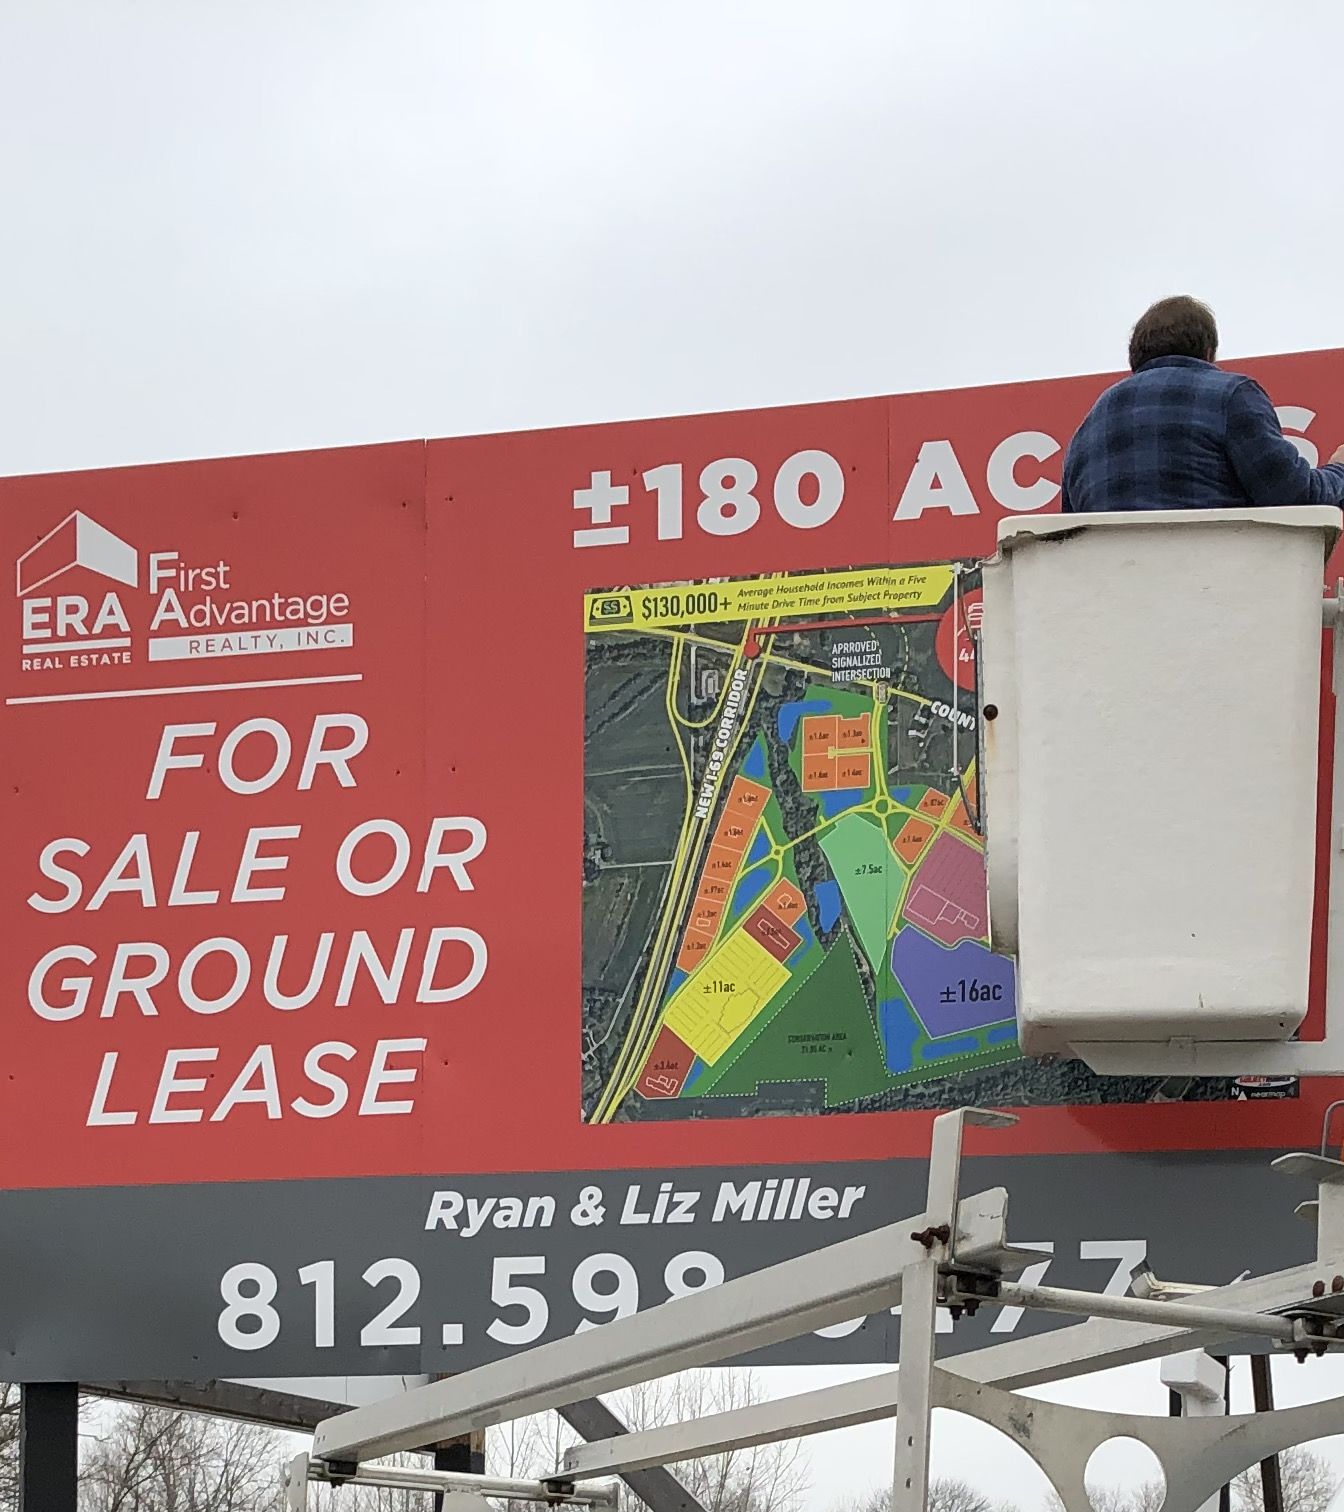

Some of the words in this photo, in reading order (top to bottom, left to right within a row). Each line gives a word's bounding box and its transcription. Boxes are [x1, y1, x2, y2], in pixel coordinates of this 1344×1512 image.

[149, 551, 231, 594] First
[737, 587, 775, 599] Average
[776, 581, 825, 595] Household
[827, 578, 864, 590] Incomes
[867, 576, 897, 588] Within
[907, 575, 927, 585] Five
[22, 591, 131, 640] ERA
[149, 588, 350, 631] Advantage
[642, 591, 732, 621] $130,000+
[737, 602, 769, 612] Minute
[772, 599, 796, 609] Drive
[798, 596, 821, 607] Time
[822, 595, 845, 607] from
[847, 591, 881, 605] Subject
[883, 589, 923, 602] Property
[189, 633, 284, 655] REALTY,
[297, 629, 346, 646] INC.
[22, 657, 64, 671] REAL
[69, 651, 132, 667] ESTATE
[831, 654, 882, 669] SIGNALIZED
[715, 668, 748, 748] CORRIDOR
[145, 712, 369, 801] FOR
[706, 751, 725, 781] I-69
[695, 782, 715, 819] NEW
[27, 823, 302, 914] SALE
[335, 815, 488, 898] OR
[27, 926, 489, 1022] GROUND
[703, 980, 736, 994] ±11ac
[940, 978, 1003, 1003] ±16ac
[85, 1037, 428, 1127] LEASE
[424, 1190, 557, 1238] Ryan
[570, 1185, 608, 1226] &
[619, 1181, 702, 1226] Liz
[711, 1177, 867, 1224] Miller
